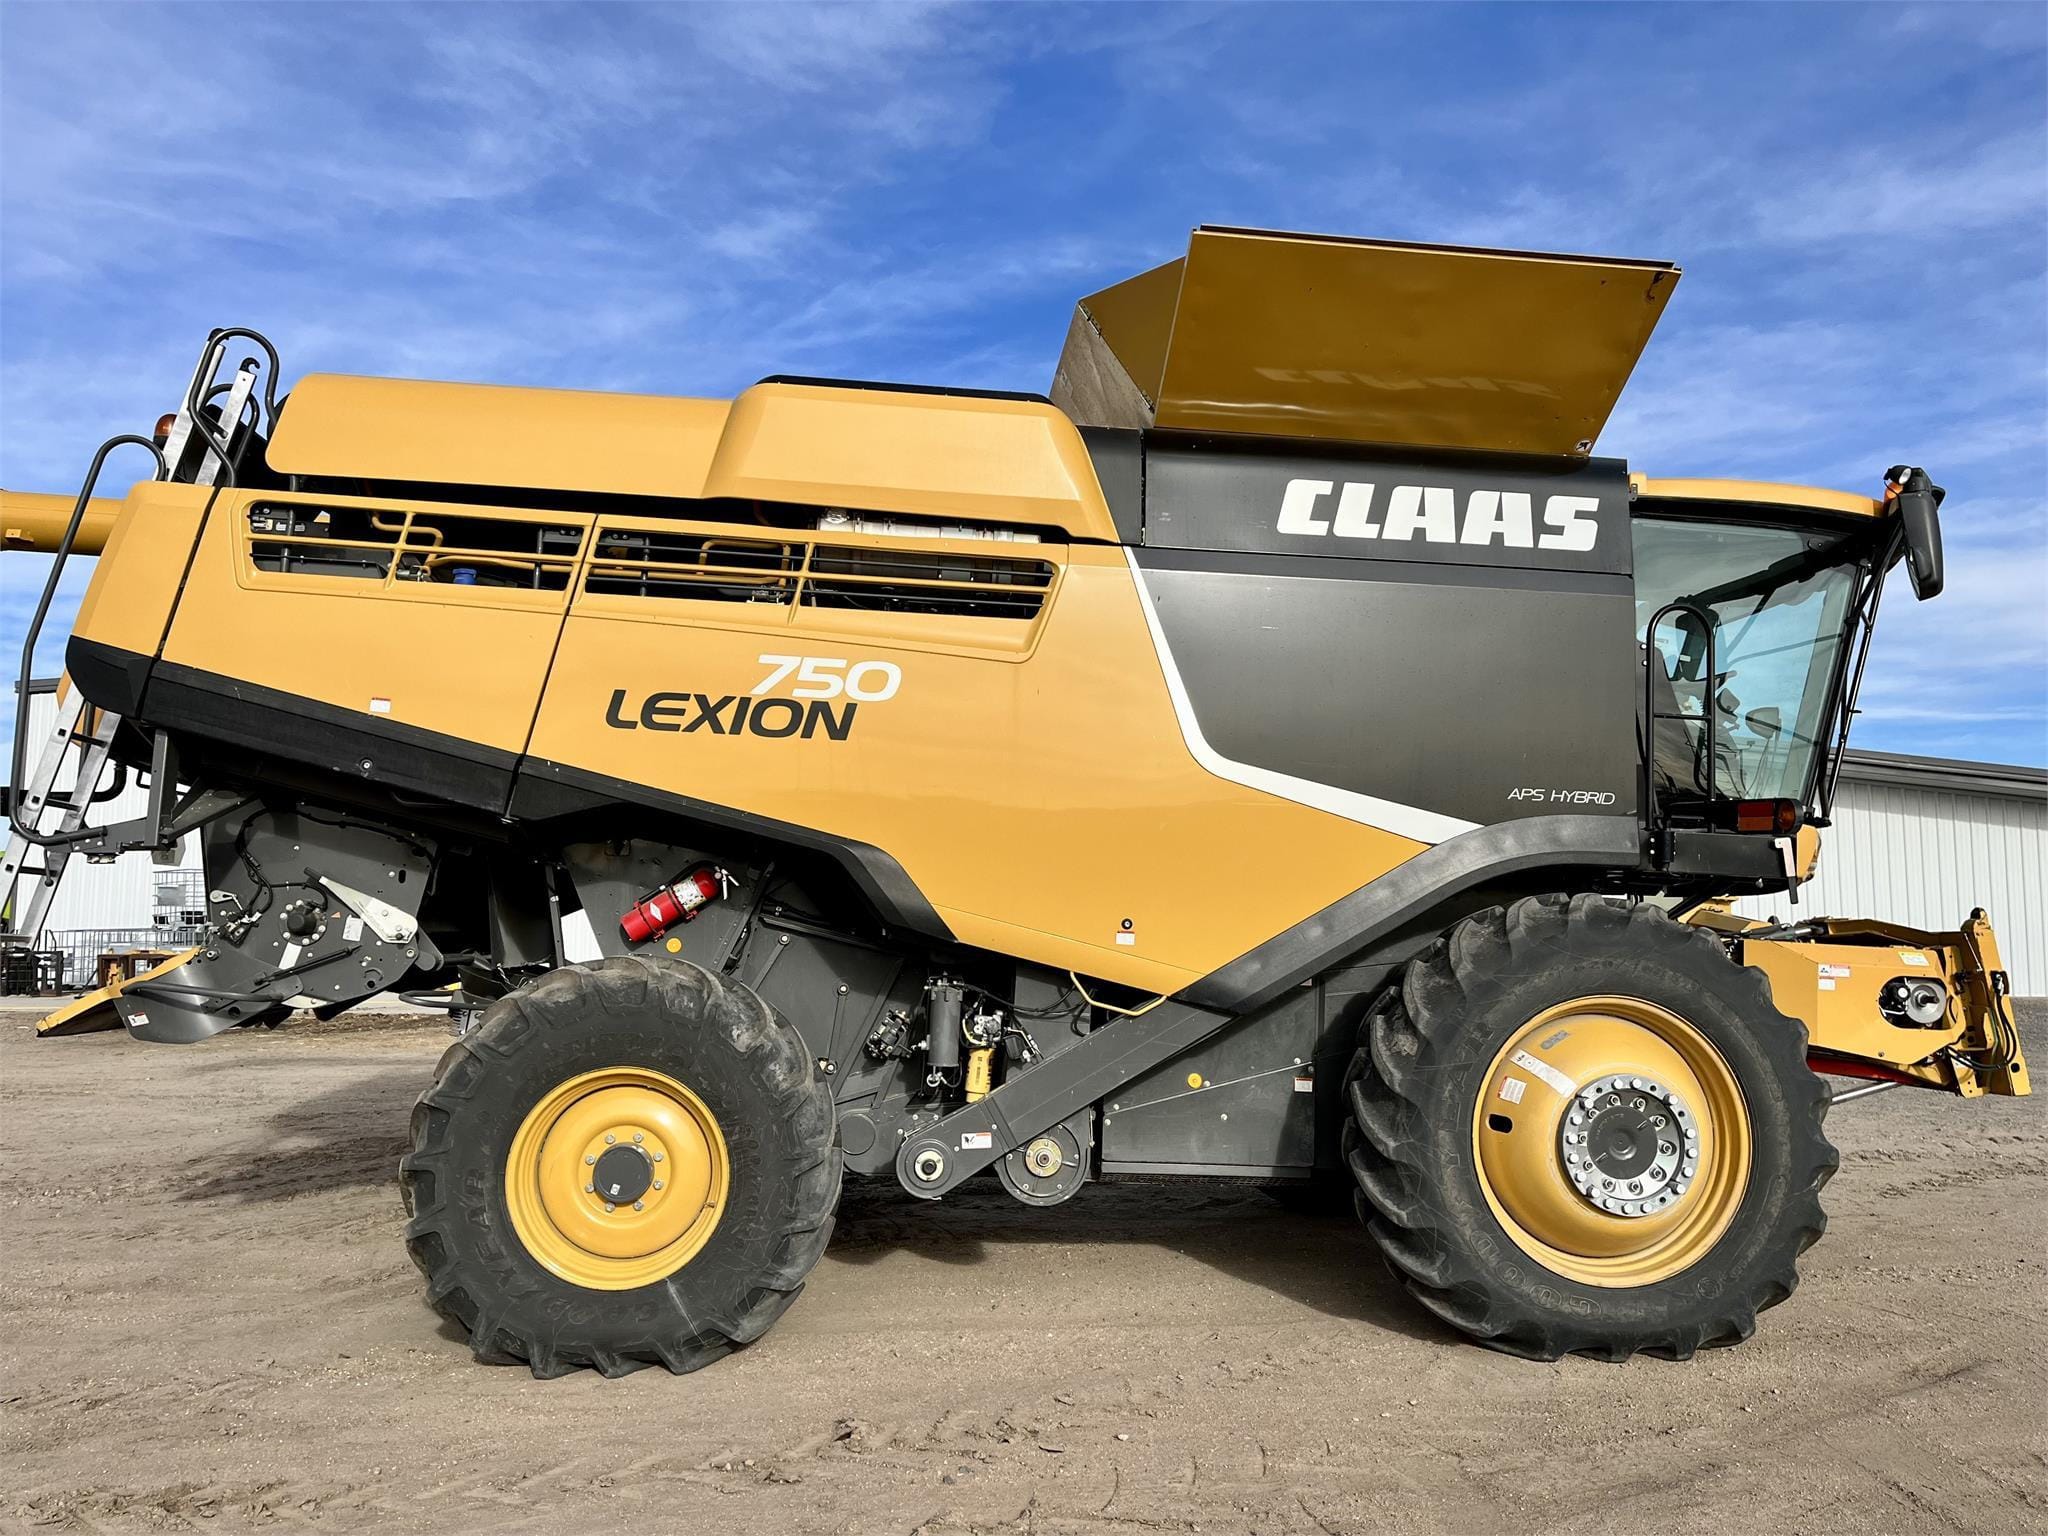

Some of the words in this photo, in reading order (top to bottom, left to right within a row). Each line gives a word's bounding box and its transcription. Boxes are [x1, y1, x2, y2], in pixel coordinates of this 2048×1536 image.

[1276, 478, 1600, 552] CLAAS
[751, 654, 902, 702] 750
[605, 689, 858, 741] LEXION
[1507, 788, 1546, 802] APS
[1550, 789, 1616, 805] HYBRID
